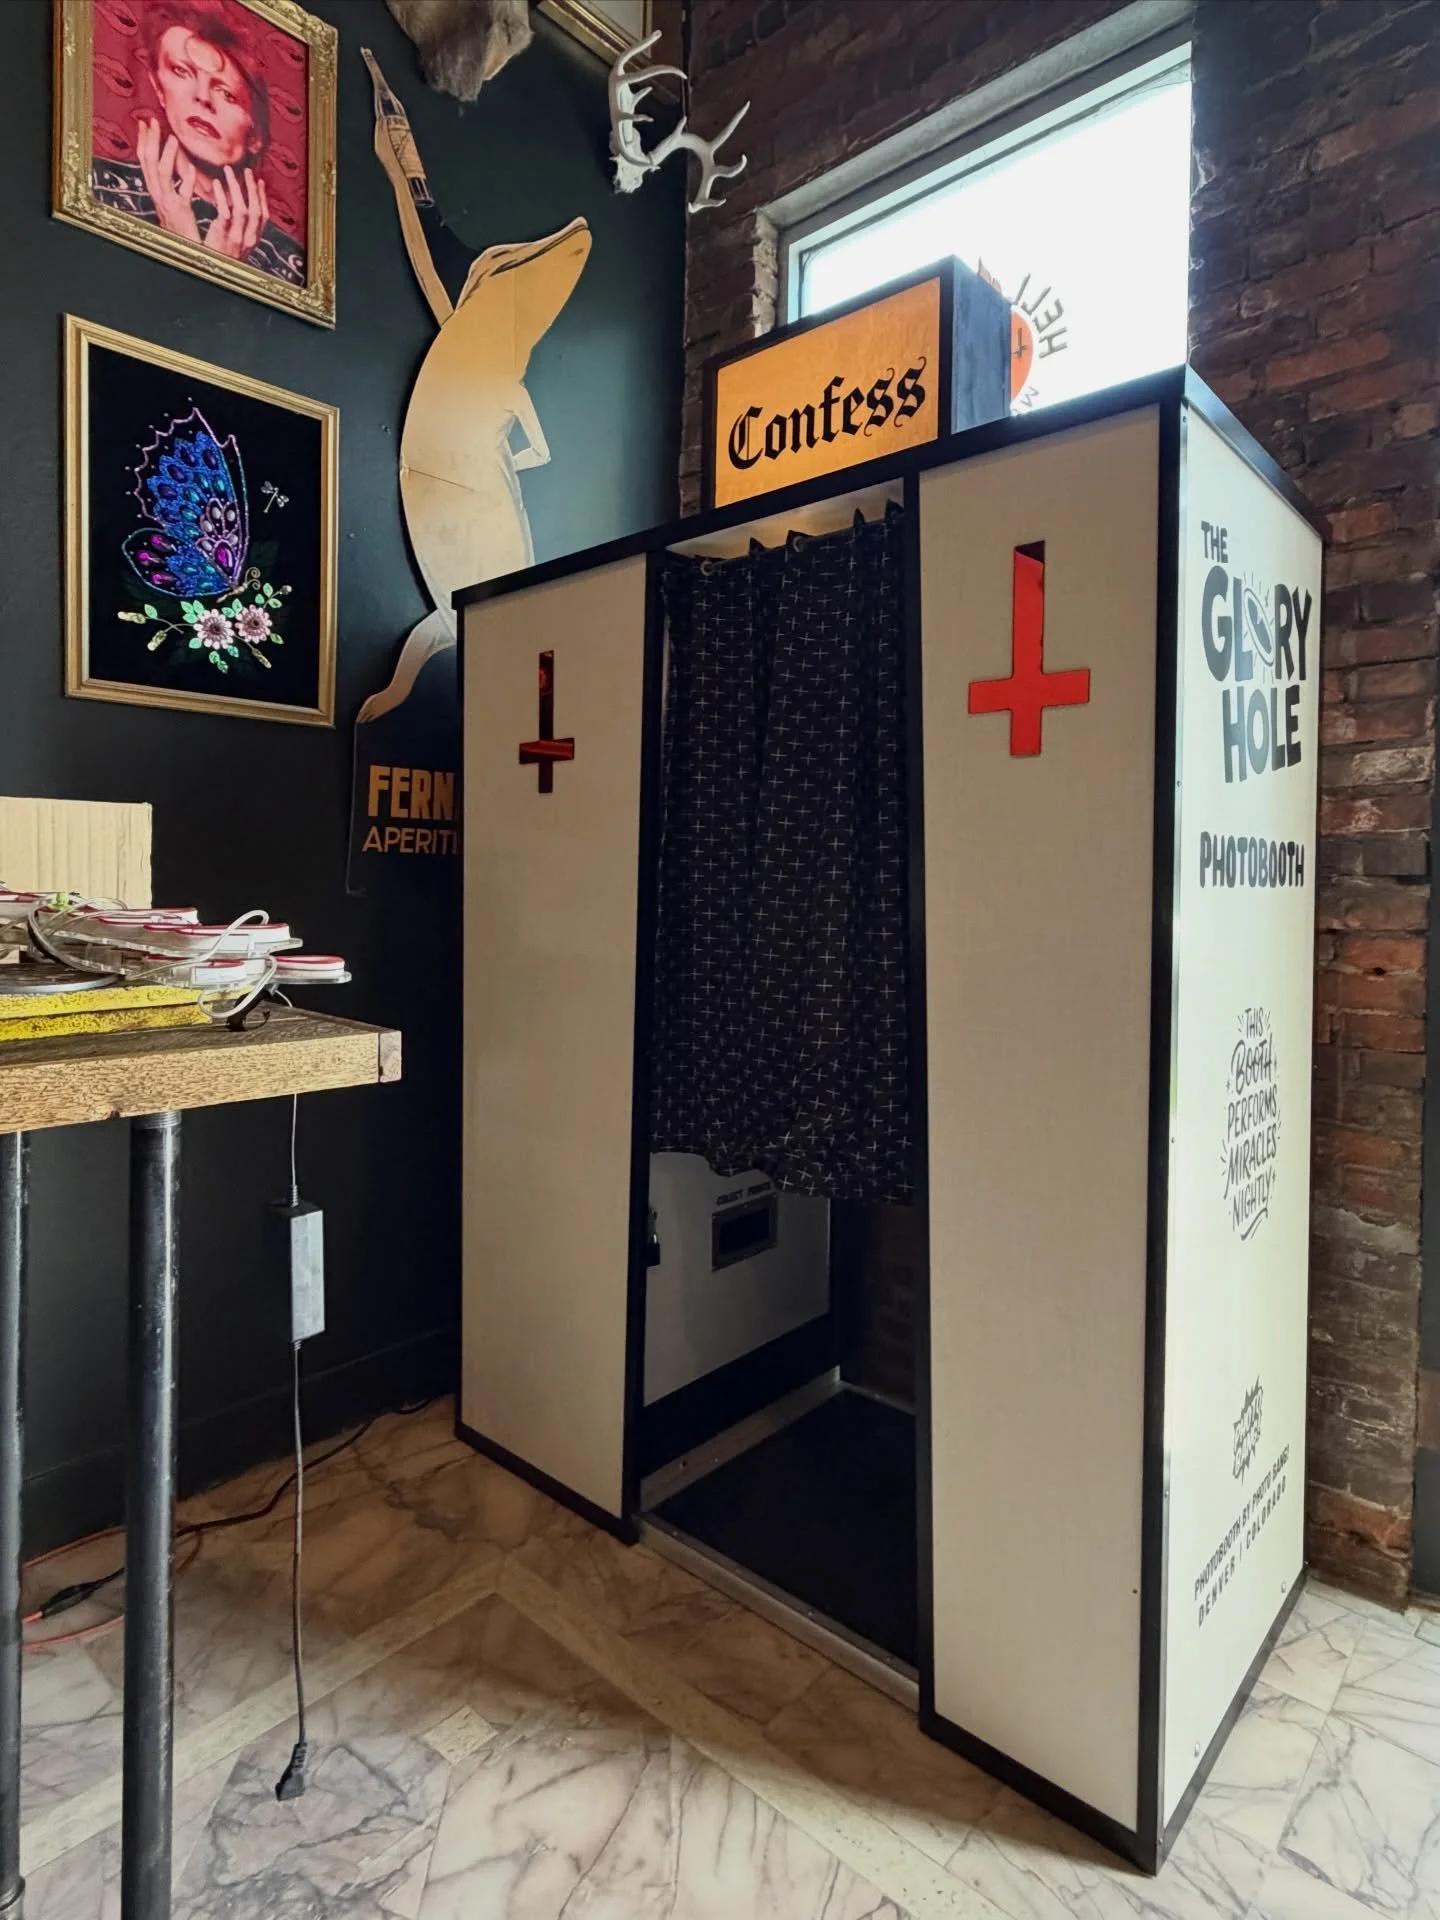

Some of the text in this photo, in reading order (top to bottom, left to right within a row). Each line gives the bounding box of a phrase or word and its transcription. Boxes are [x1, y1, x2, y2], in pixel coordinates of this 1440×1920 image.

[728, 356, 926, 470] Confess
[1201, 520, 1229, 563] THE
[1201, 565, 1312, 682] GLORY
[1222, 684, 1302, 783] HOLE
[1199, 831, 1304, 888] PHOTOBOOTH
[1245, 1007, 1264, 1039] THIS
[1231, 1032, 1273, 1095] BOOTH
[1227, 1084, 1277, 1141] PERFORMS
[1224, 1122, 1277, 1200] MIRACLES
[1232, 1165, 1272, 1232] NIGHTLY
[1194, 1514, 1241, 1601] PHOTOBOOTH
[1242, 1500, 1251, 1527] BY
[1198, 1555, 1235, 1629] DENVER
[1246, 1474, 1286, 1550] COLORADO
